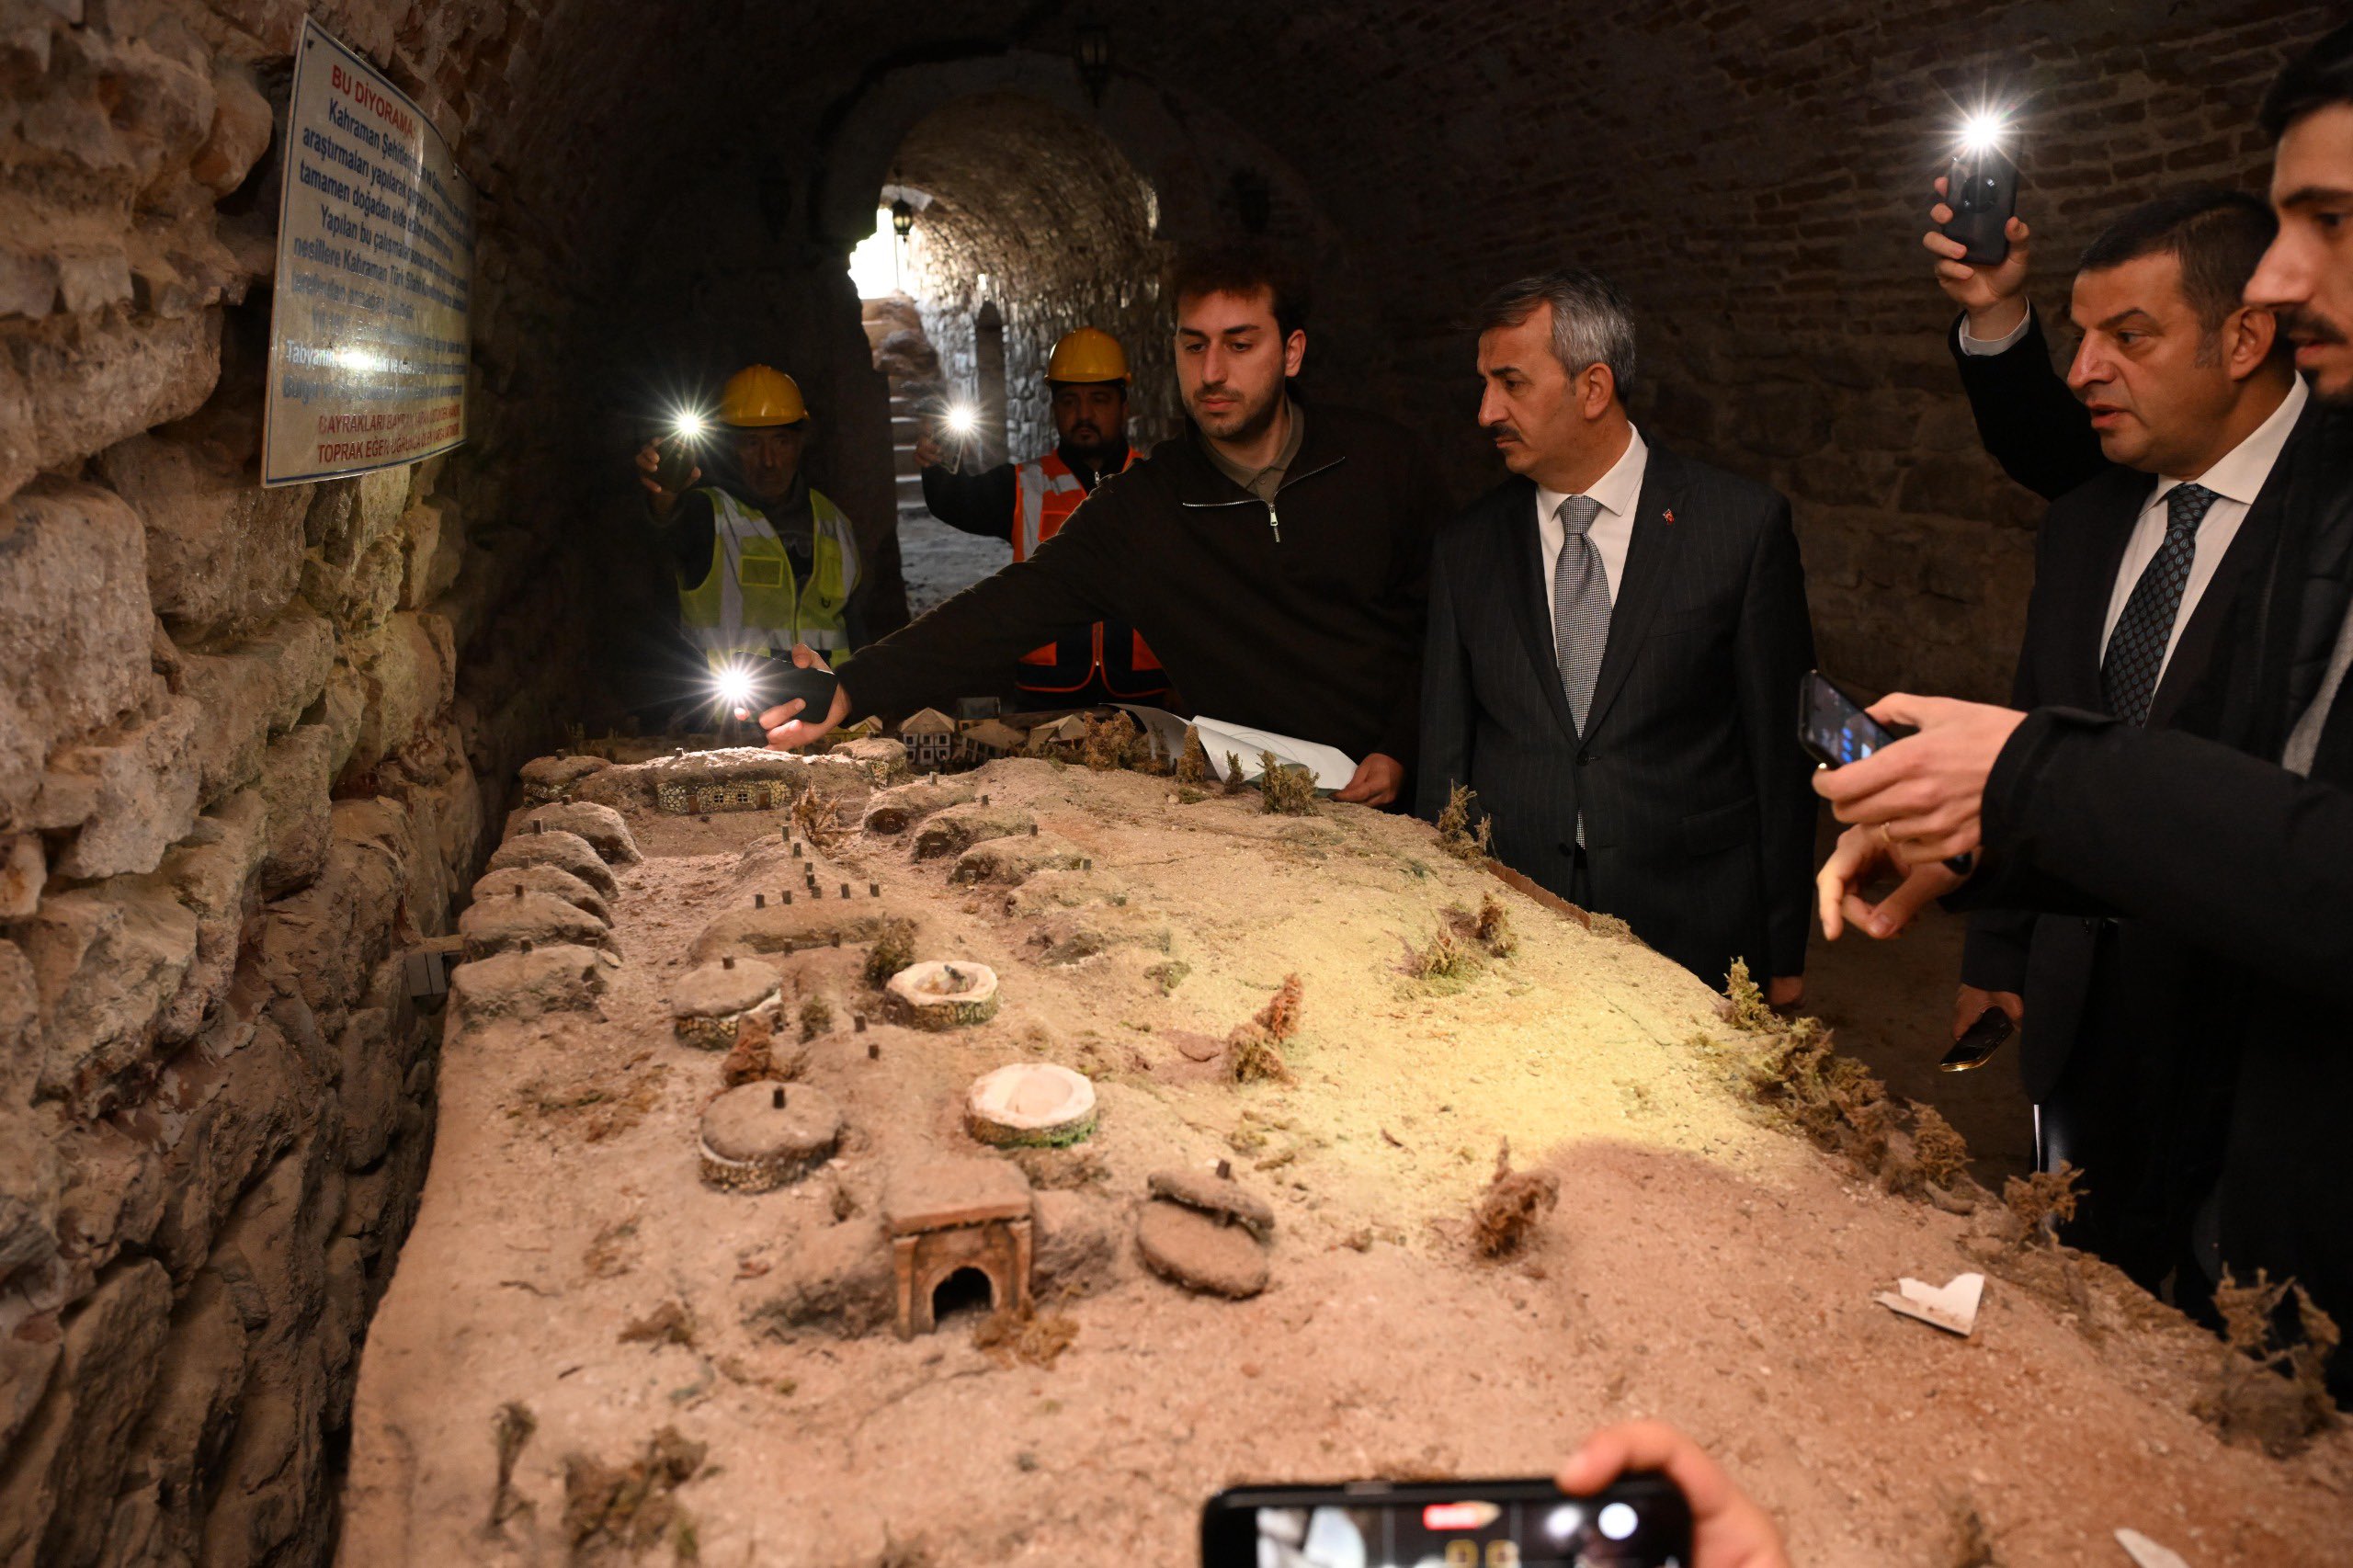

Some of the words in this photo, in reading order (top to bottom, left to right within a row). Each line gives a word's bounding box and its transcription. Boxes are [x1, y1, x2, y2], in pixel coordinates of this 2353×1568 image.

[331, 64, 352, 96] BU
[328, 97, 380, 148] Kahraman
[302, 127, 369, 178] araştırmaları
[370, 162, 407, 199] yapılarak
[300, 160, 350, 203] tamamen
[352, 187, 392, 223] doğadan
[392, 206, 407, 230] elde
[321, 203, 358, 240] Yapılan
[360, 221, 372, 244] bu
[343, 248, 387, 282] Kahraman
[318, 413, 385, 435] BAYRAKLARI
[317, 441, 364, 464] TOPRAK
